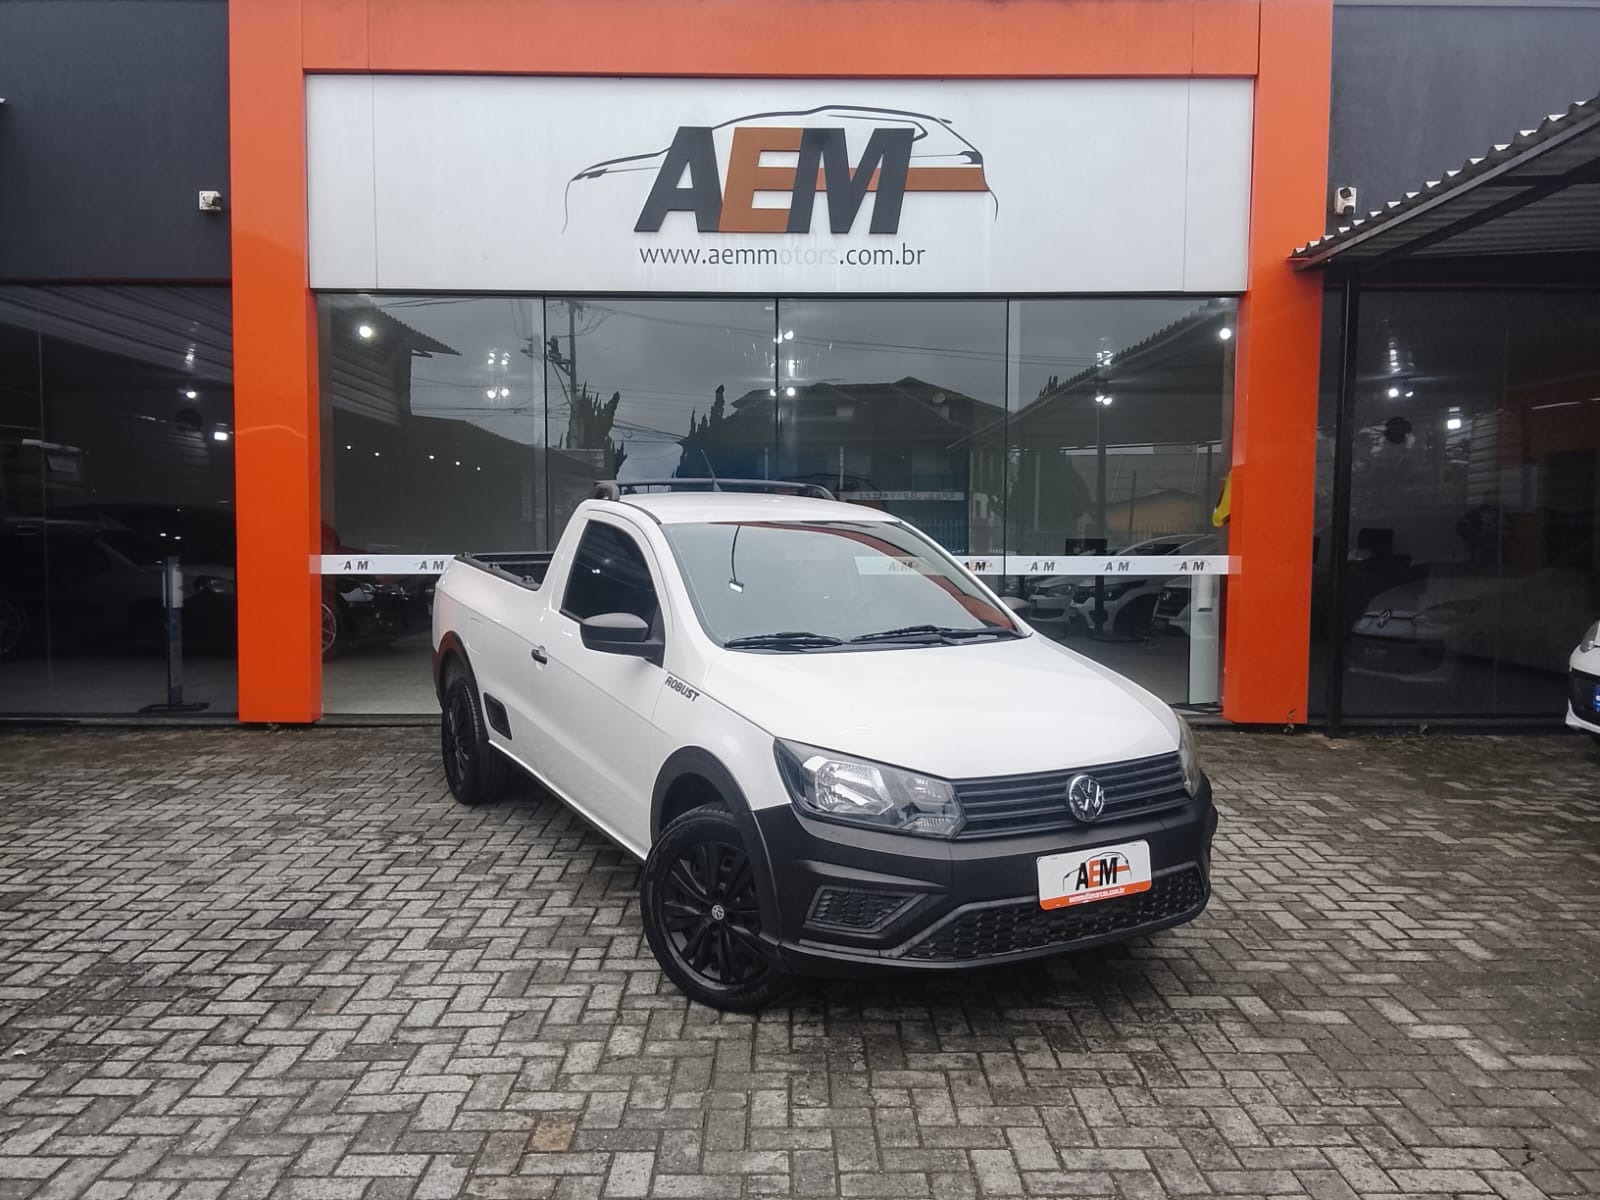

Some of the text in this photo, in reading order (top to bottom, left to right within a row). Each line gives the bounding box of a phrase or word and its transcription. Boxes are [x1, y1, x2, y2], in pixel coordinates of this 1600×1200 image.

[634, 126, 916, 234] AEM
[639, 243, 926, 265] www.aemmotors.com.br
[664, 675, 700, 702] ROBUST
[1075, 857, 1118, 891] AEM
